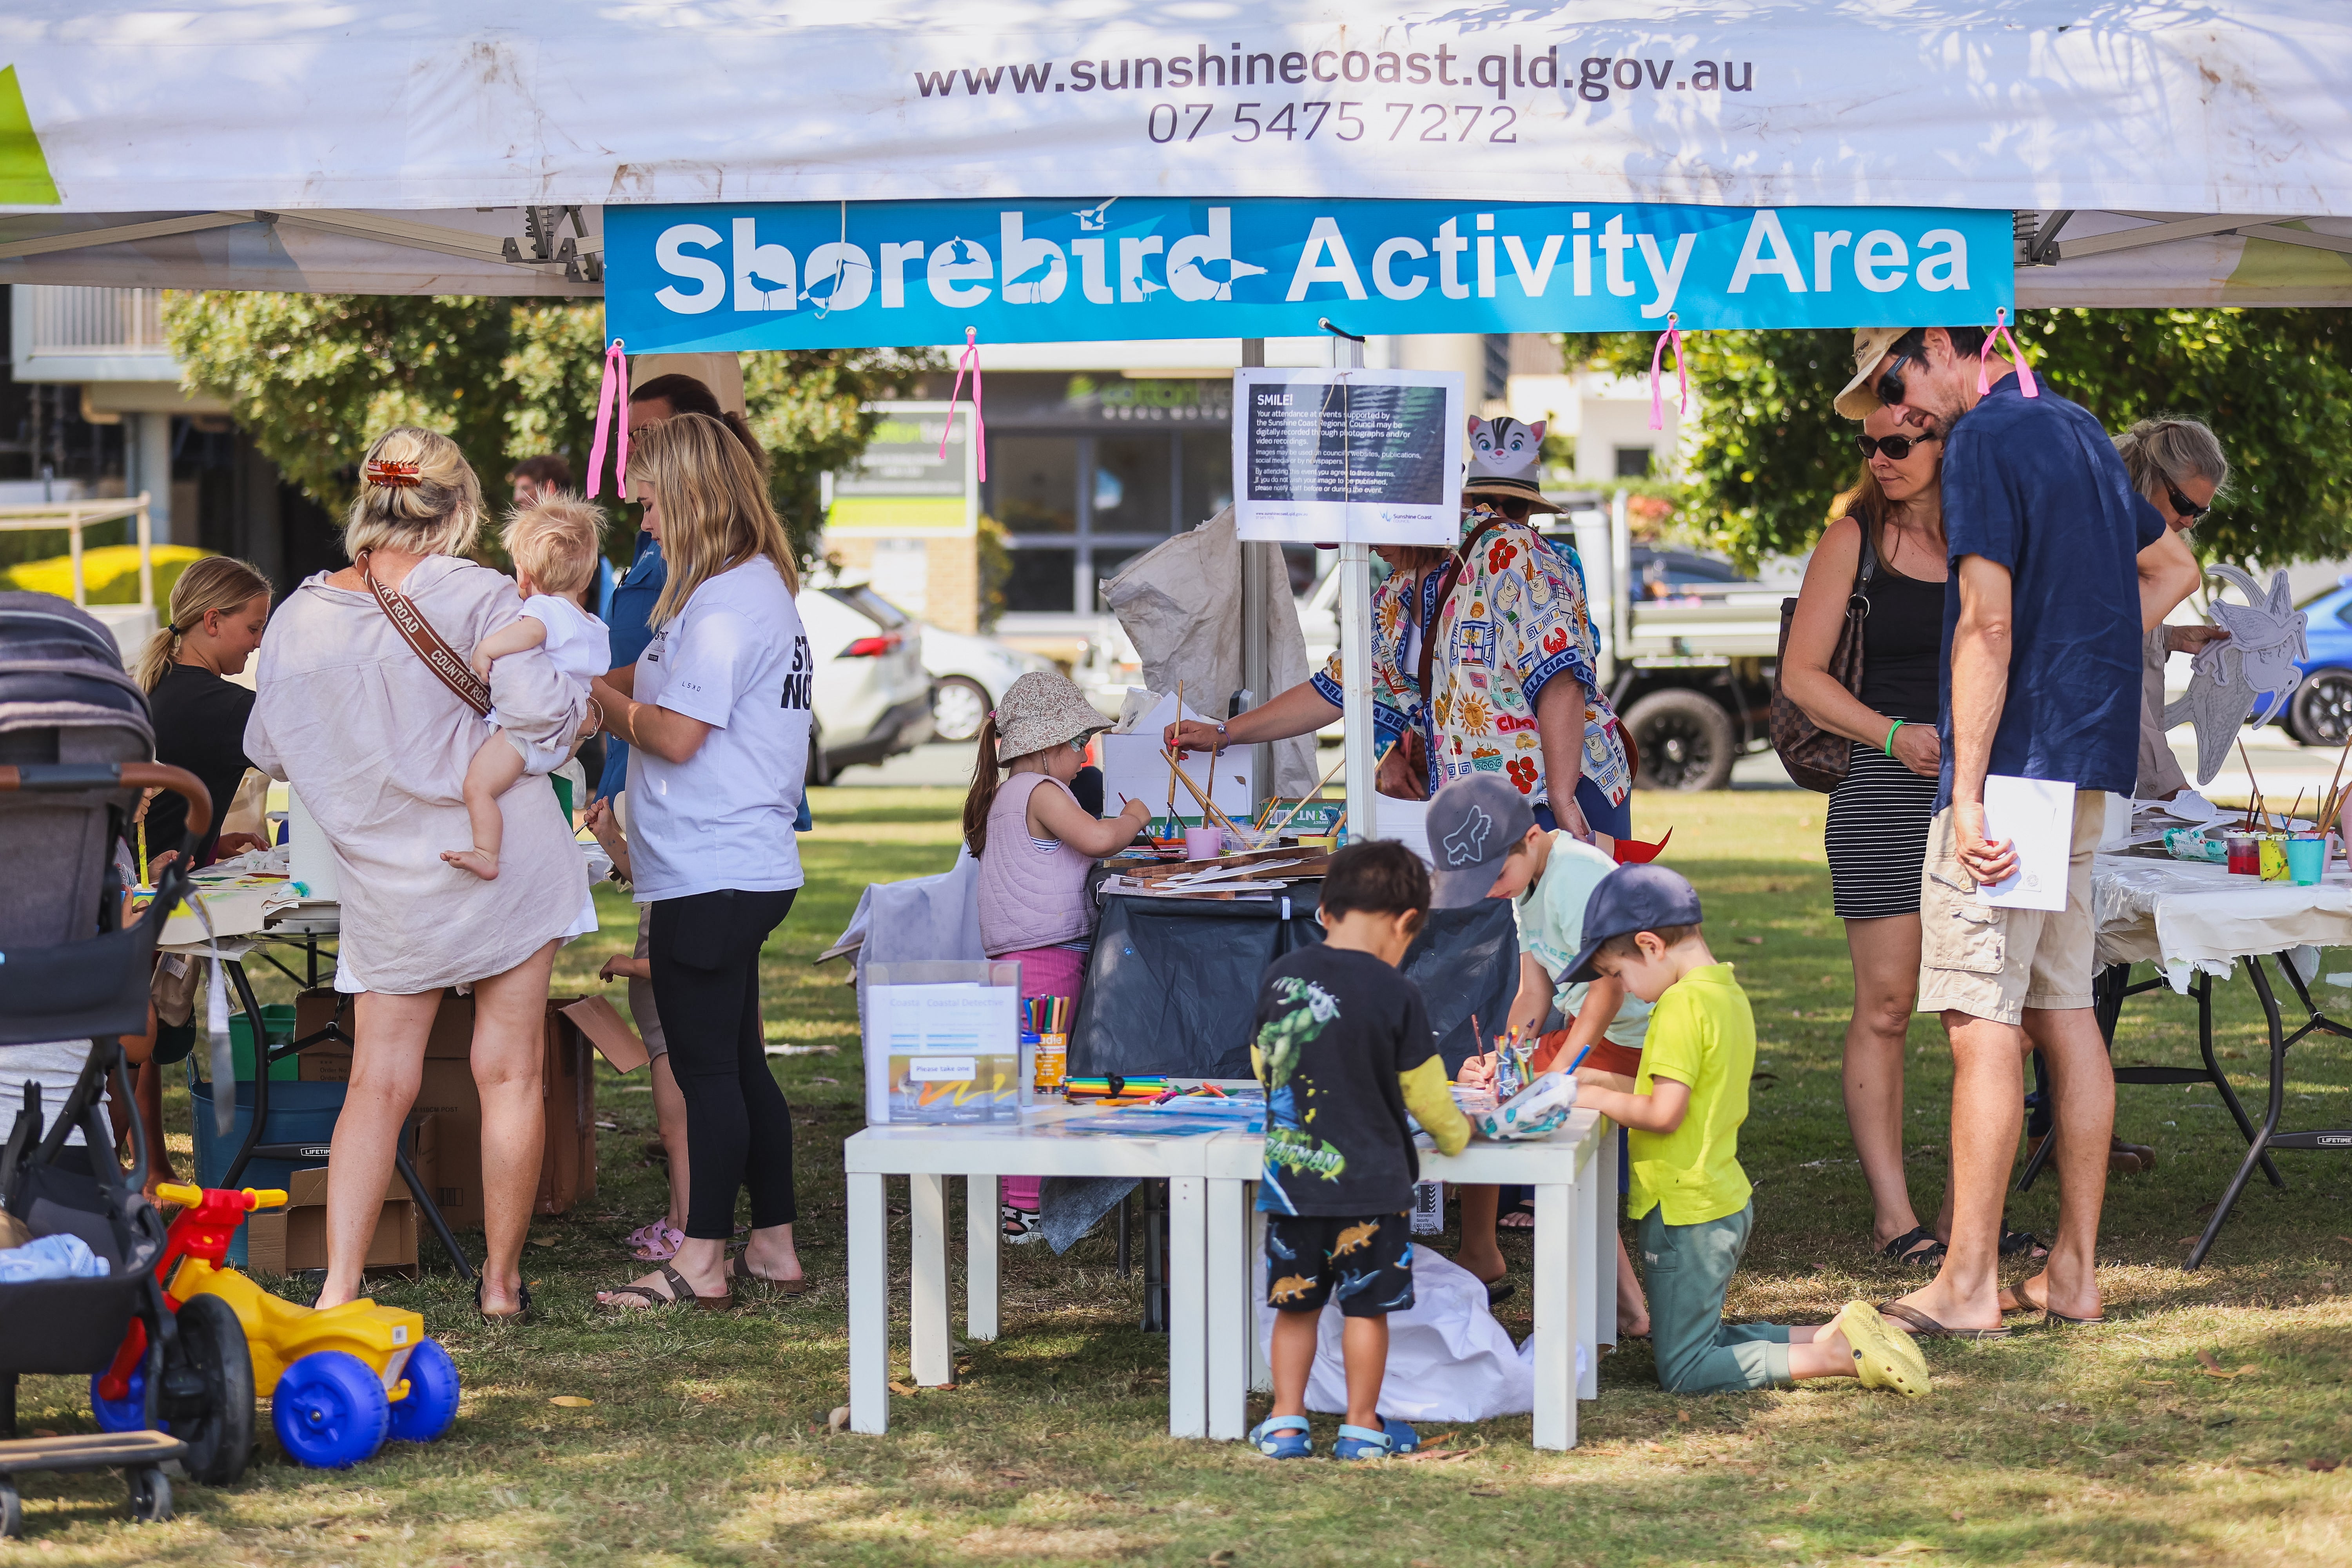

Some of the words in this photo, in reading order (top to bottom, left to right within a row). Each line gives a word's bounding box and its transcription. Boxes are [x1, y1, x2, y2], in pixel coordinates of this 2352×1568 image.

[915, 43, 1752, 102] www.sunshinecoast.qld.gov.au
[1147, 103, 1214, 143] 07
[1231, 102, 1365, 143] 5475
[1385, 103, 1517, 143] 7272
[654, 207, 1232, 315] Shorebird
[1285, 211, 1696, 318] Activity
[1727, 209, 1969, 294] Area
[1258, 394, 1293, 406] SMILE!
[1381, 412, 1390, 420] by
[1256, 428, 1280, 437] digitally
[392, 601, 419, 633] ROAD
[431, 650, 475, 690] COUNTRY
[1524, 674, 1544, 701] ELLA
[1543, 652, 1576, 675] CIAO
[1040, 1035, 1062, 1044] udie
[1265, 1137, 1343, 1172] BATMAN
